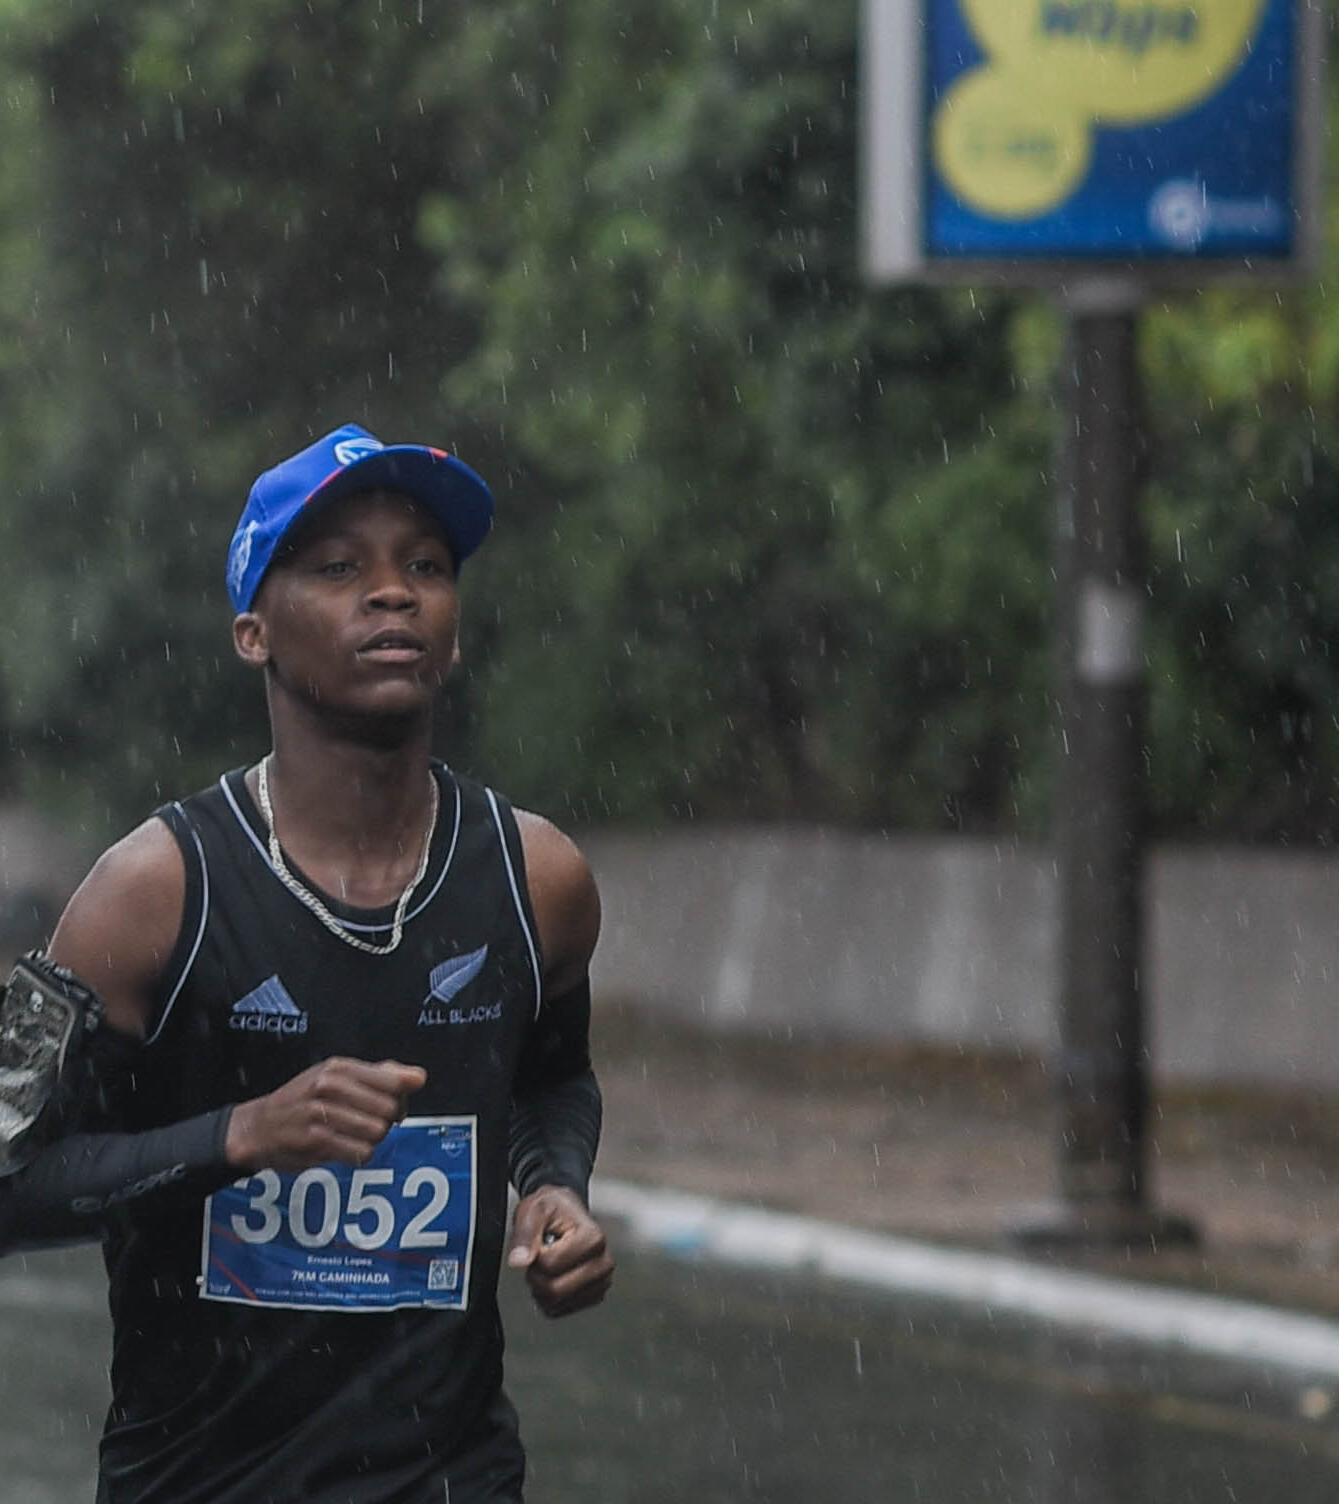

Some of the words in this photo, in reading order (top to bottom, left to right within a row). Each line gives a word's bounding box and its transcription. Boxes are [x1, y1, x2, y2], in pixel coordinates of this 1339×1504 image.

[228, 1011, 308, 1034] adidas
[417, 1008, 447, 1025] ALL
[449, 1001, 502, 1025] BLACKS
[229, 1166, 451, 1252] 3052
[291, 1269, 317, 1284] 7KM
[319, 1270, 390, 1285] CAMINHADA
